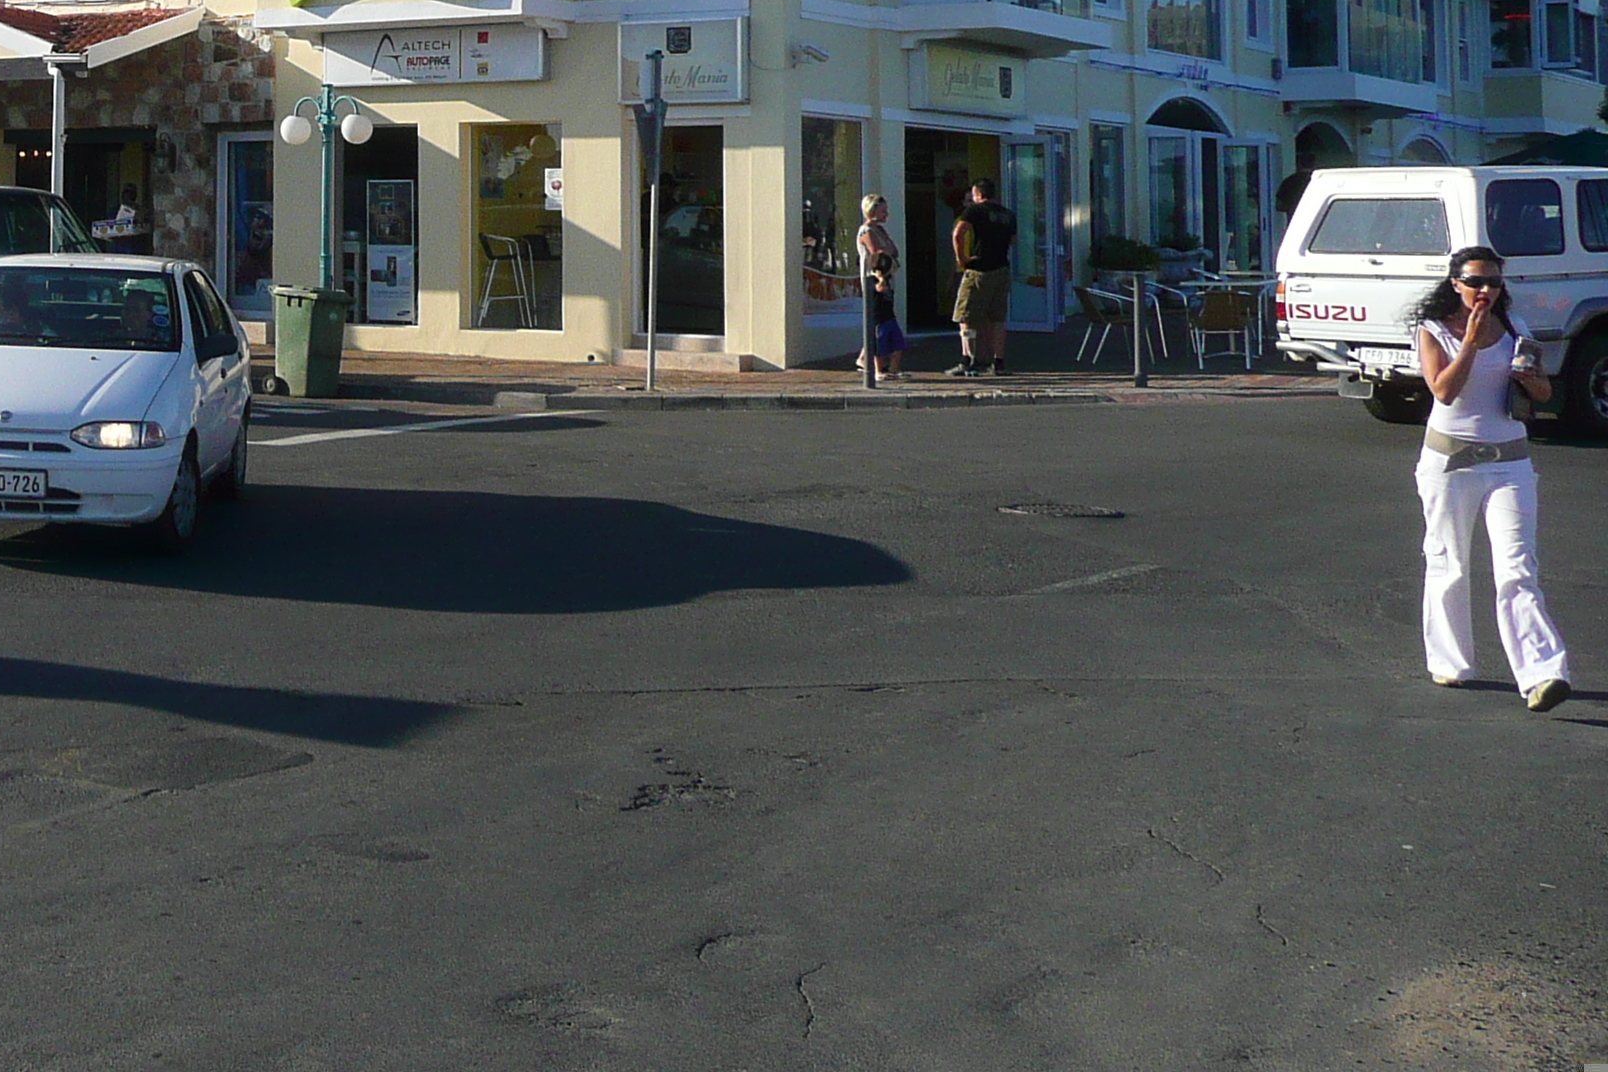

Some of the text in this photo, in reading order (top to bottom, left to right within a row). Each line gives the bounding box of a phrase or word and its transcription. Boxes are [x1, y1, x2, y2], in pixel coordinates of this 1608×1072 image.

[402, 40, 451, 52] ALTECH
[406, 55, 451, 67] AUTOPAGE
[683, 65, 729, 88] Mania
[1289, 303, 1367, 322] ISUZU
[1388, 350, 1412, 365] 7366
